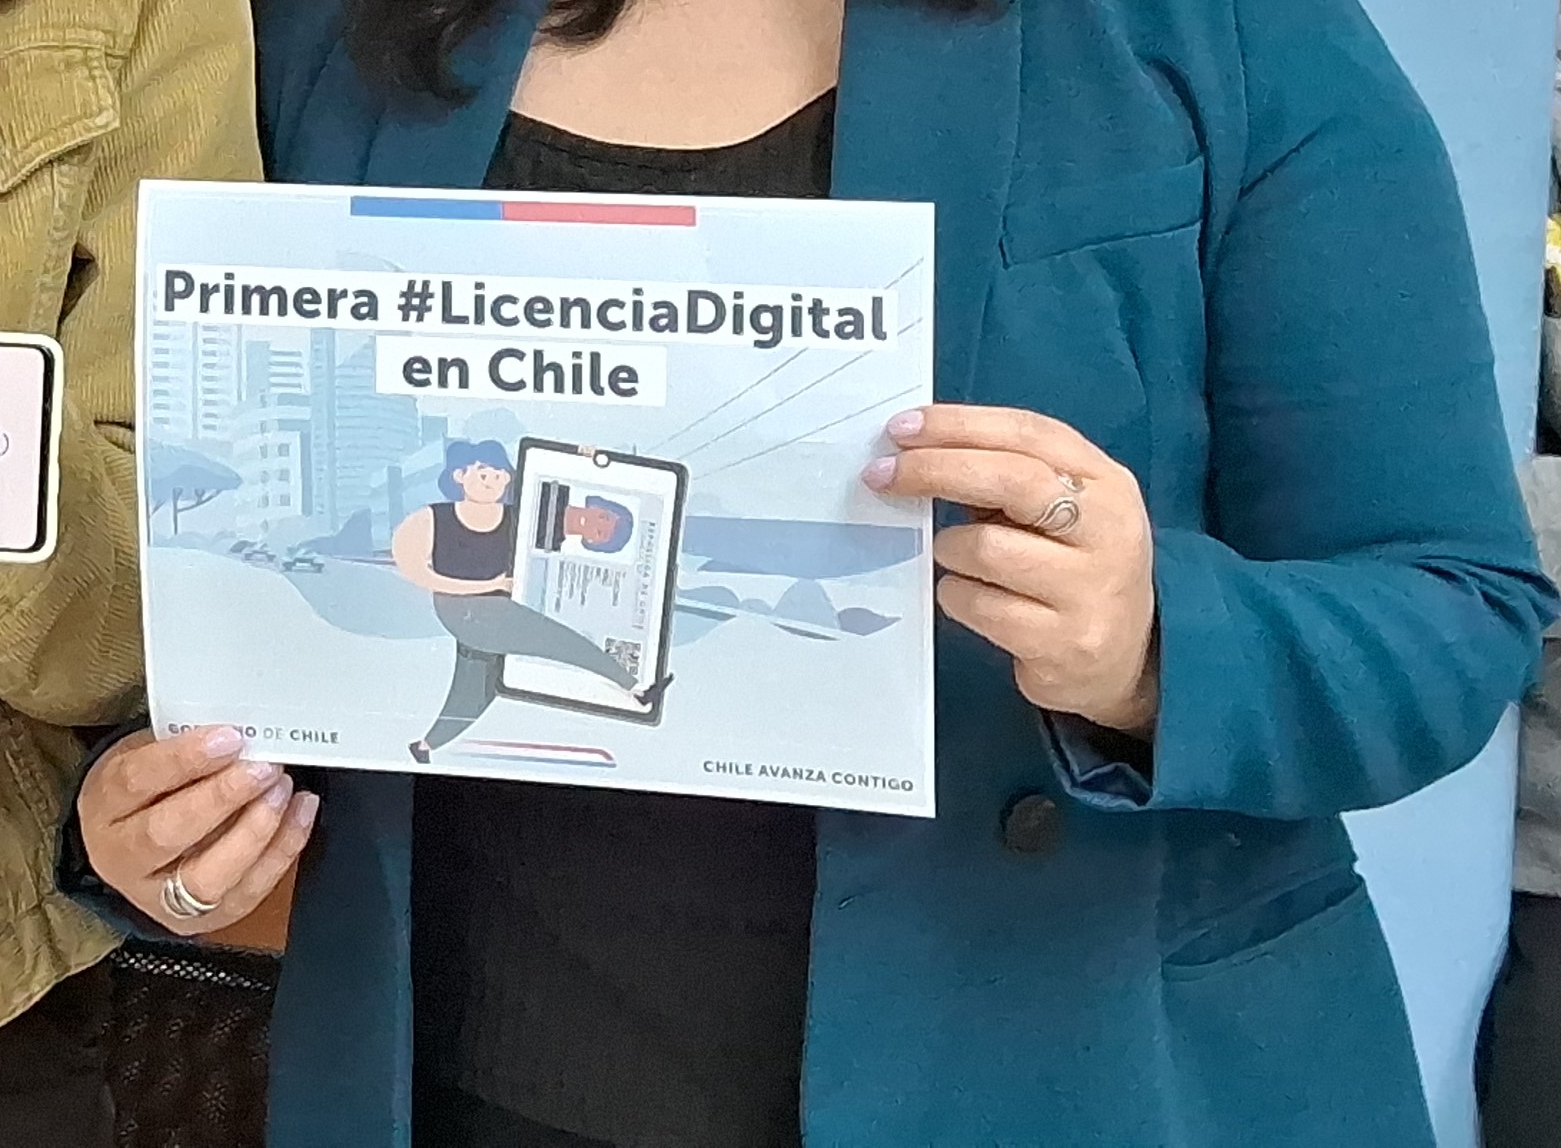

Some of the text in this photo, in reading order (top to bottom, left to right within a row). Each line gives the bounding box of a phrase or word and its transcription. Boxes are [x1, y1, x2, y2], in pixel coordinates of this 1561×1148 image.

[163, 269, 888, 350] Primera #LicenciaDigital
[401, 348, 640, 398] en Chile
[263, 727, 284, 740] DE
[289, 728, 339, 744] CHILE
[703, 760, 914, 792] CHILE AVANZA CONTIGO
